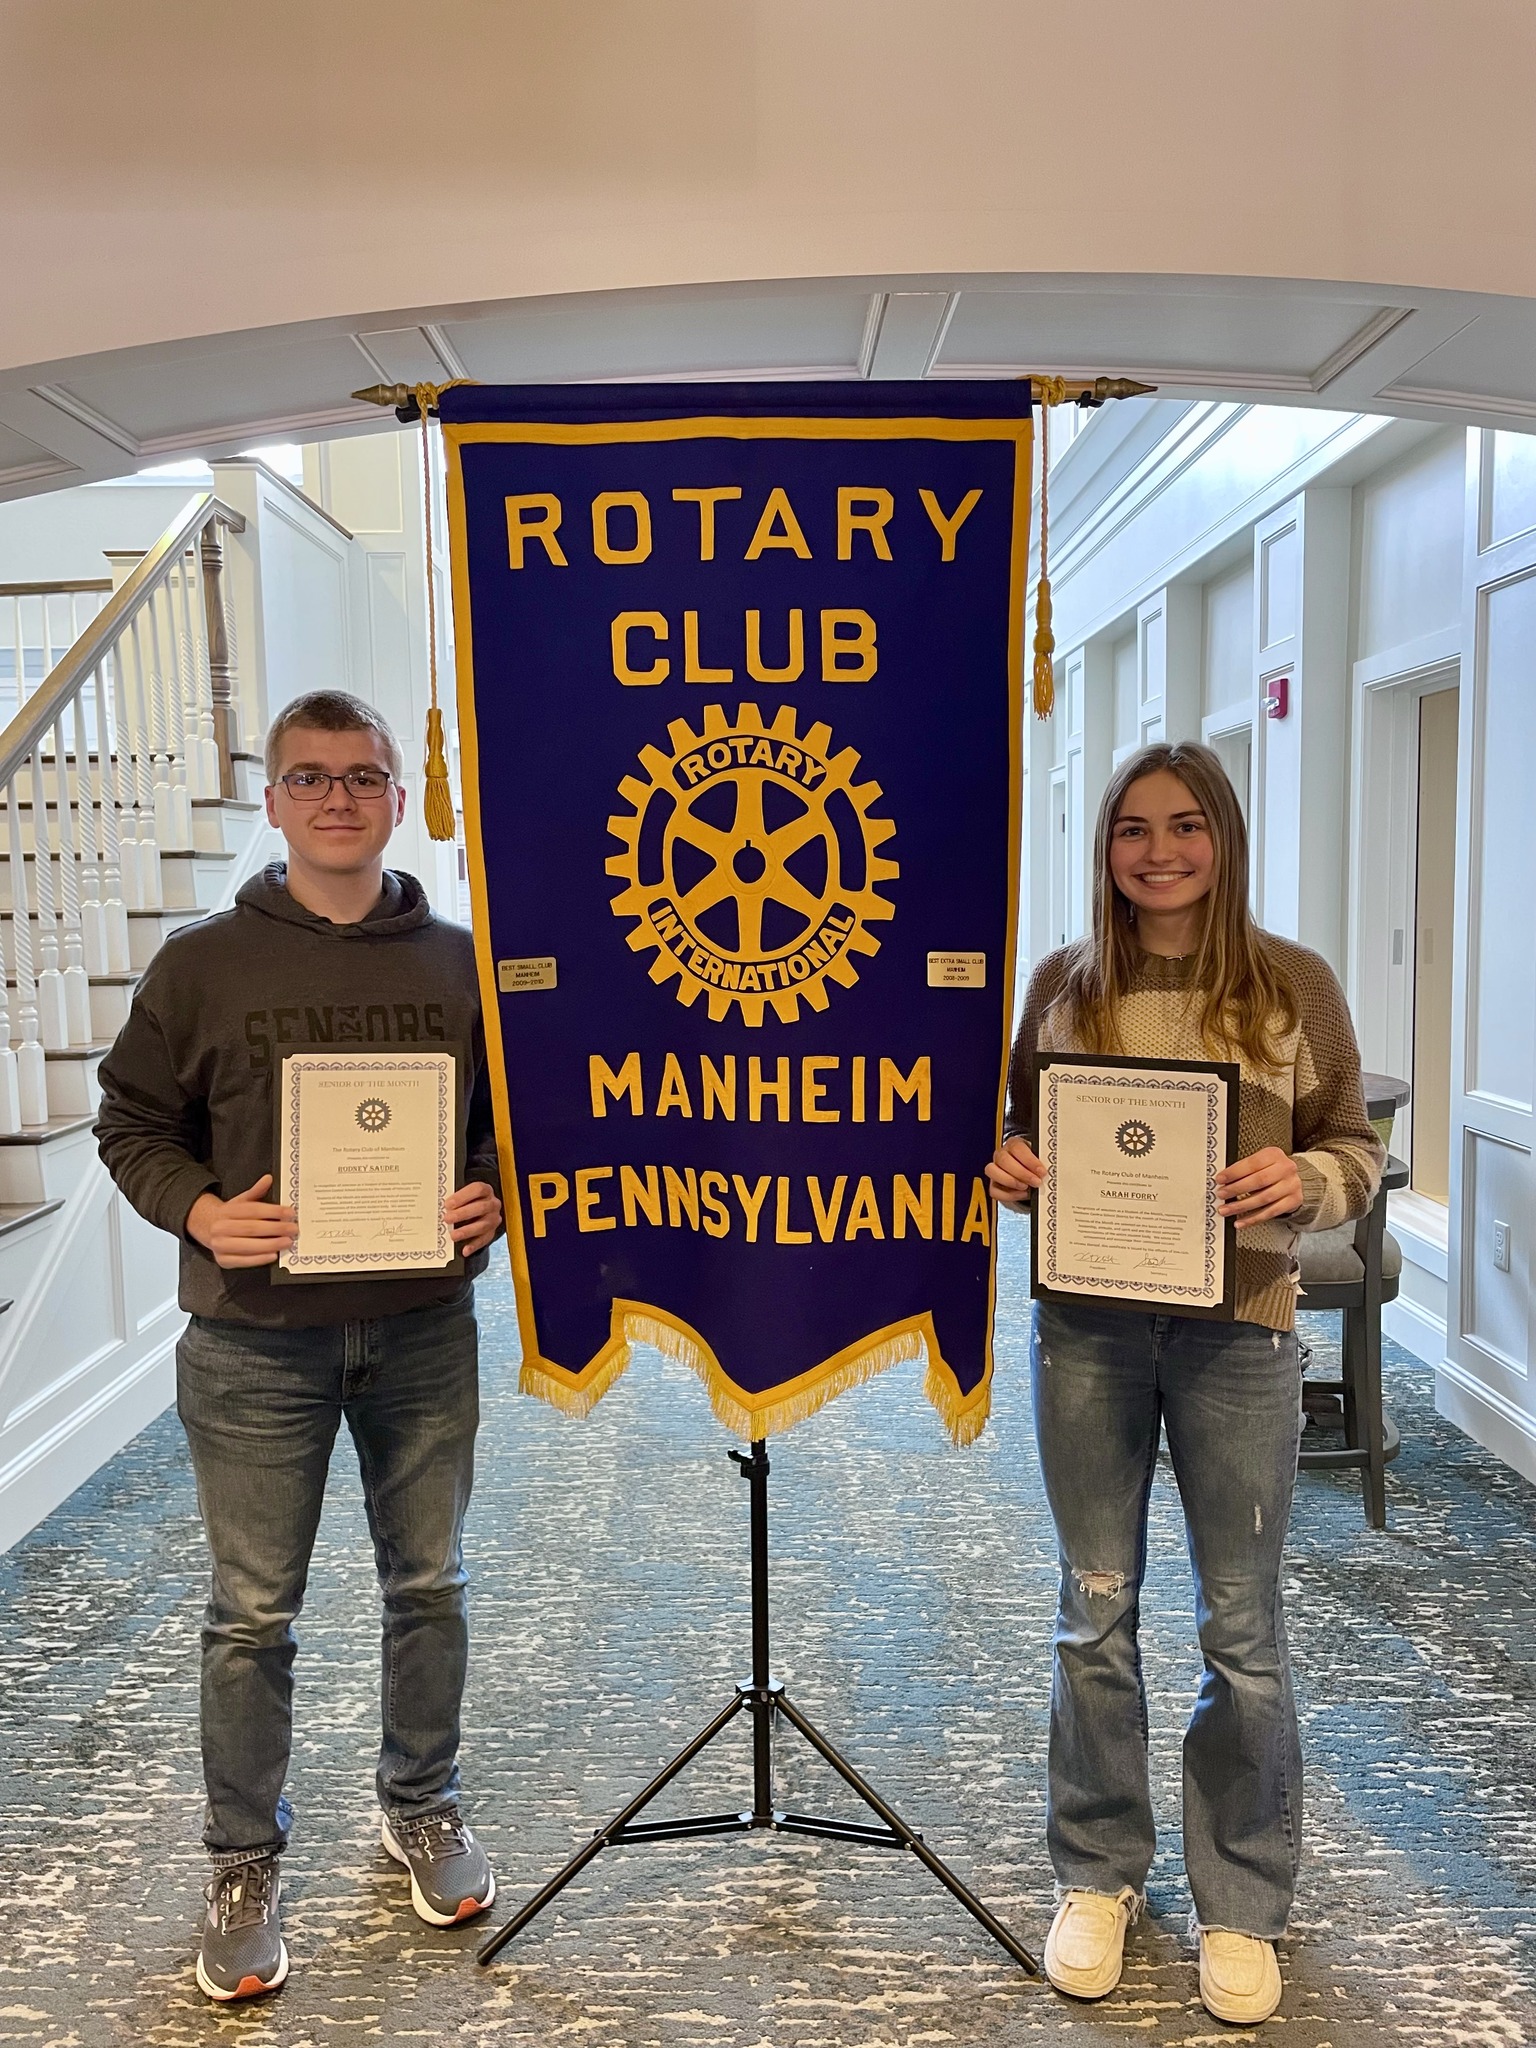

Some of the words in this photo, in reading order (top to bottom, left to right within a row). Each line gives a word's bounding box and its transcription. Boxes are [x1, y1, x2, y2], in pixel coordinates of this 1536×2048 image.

[505, 486, 983, 569] ROTARY
[611, 609, 878, 686] CLUB
[680, 737, 828, 785] ROTARY
[650, 905, 855, 991] INTERNATIONAL
[318, 1080, 351, 1088] SENIOR
[353, 1080, 363, 1088] OF
[588, 1052, 931, 1122] MANHEIM
[1076, 1094, 1111, 1104] SENIOR
[1112, 1097, 1126, 1105] OF
[1128, 1098, 1148, 1106] THE
[1149, 1100, 1186, 1109] MONTH
[338, 1165, 369, 1173] RODNEY
[1101, 1170, 1120, 1178] Rotary
[1142, 1173, 1169, 1181] Manheim
[528, 1165, 990, 1247] PENNSYLVANIA
[1100, 1189, 1129, 1199] SARAH
[1130, 1191, 1159, 1200] FORRY
